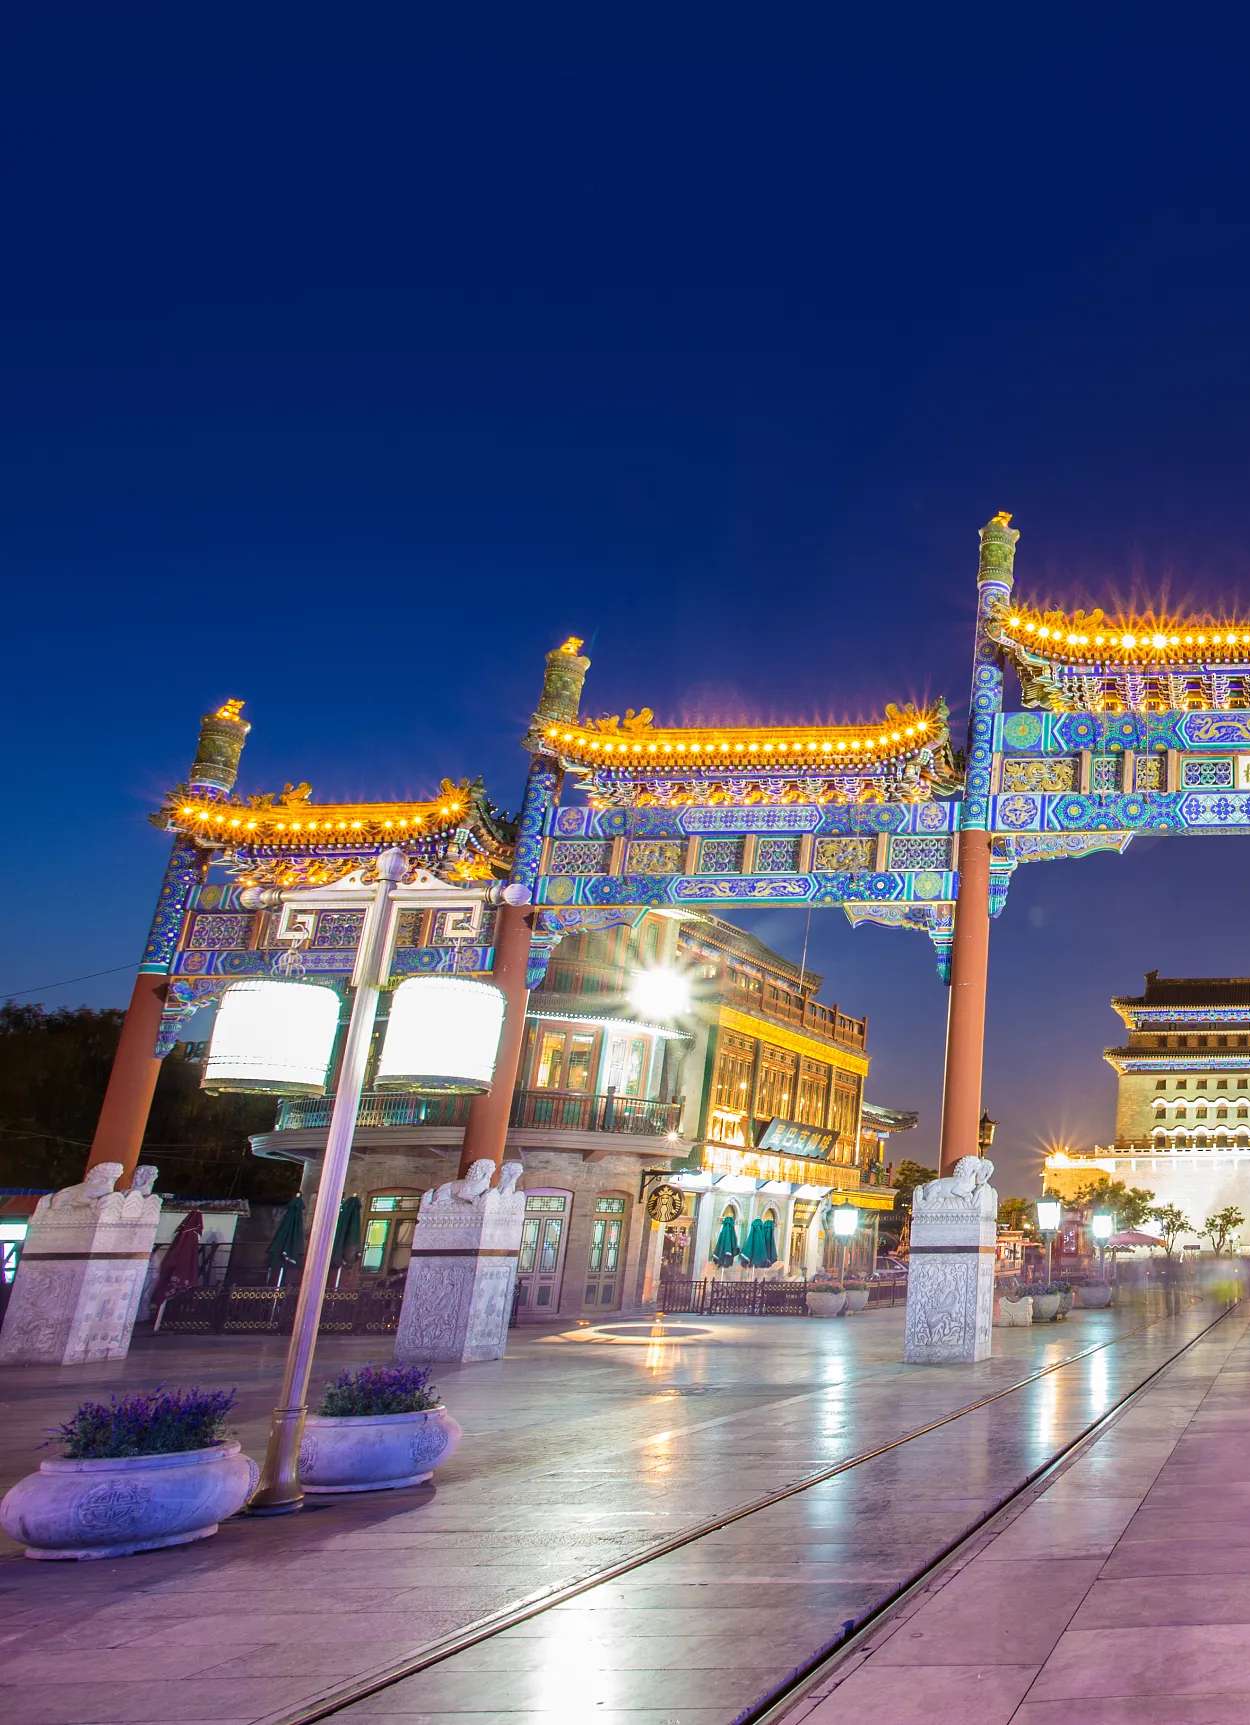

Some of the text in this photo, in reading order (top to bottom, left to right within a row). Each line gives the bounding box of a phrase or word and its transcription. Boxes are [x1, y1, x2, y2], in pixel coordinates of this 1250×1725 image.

[768, 1124, 833, 1153] 星巴克咖啡
